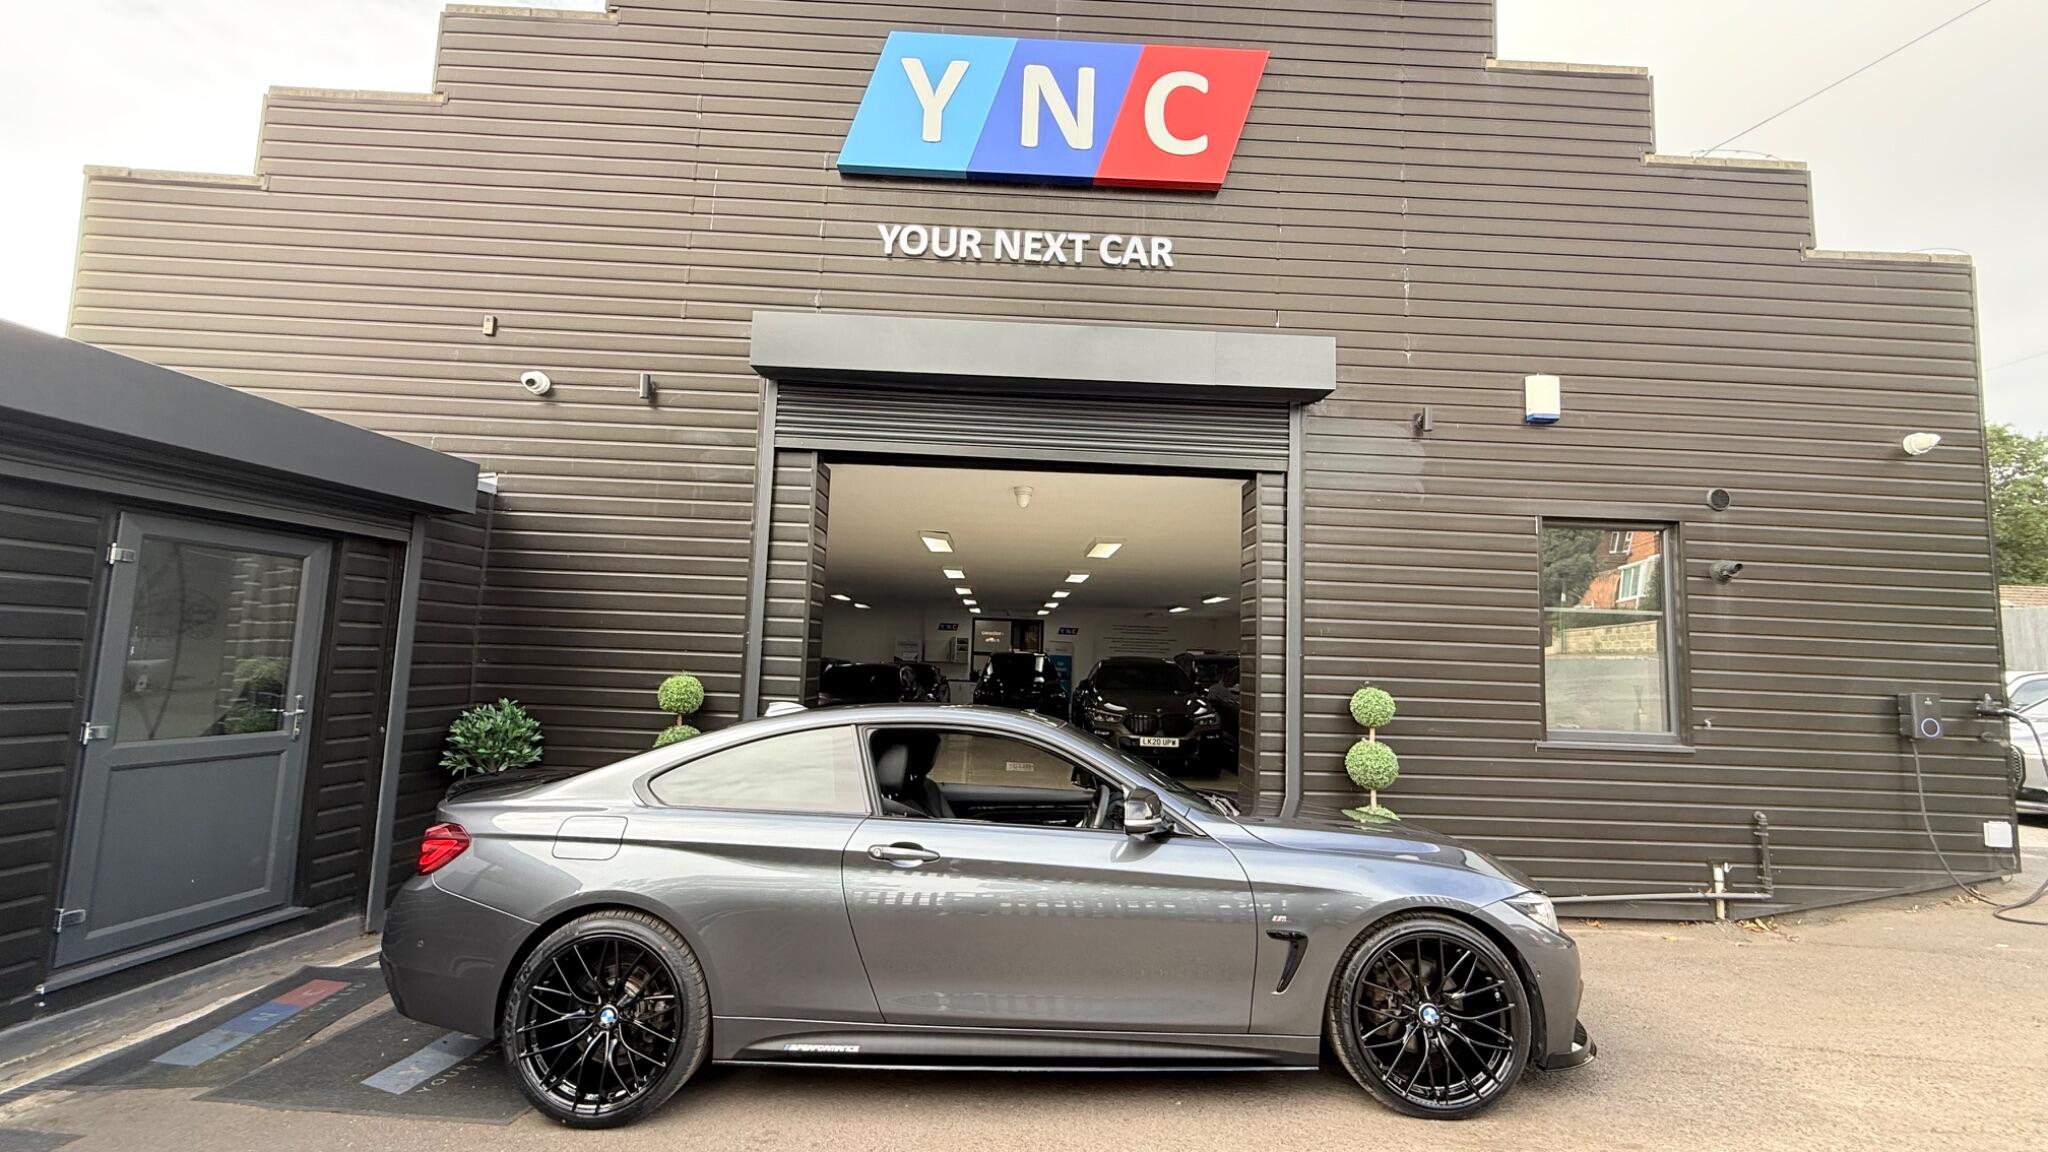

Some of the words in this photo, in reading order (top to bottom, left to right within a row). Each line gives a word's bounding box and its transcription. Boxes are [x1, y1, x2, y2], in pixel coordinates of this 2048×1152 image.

[901, 58, 1208, 156] YNC
[877, 224, 982, 260] YOUR
[994, 231, 1091, 264] NEXT
[1099, 234, 1174, 268] CAR
